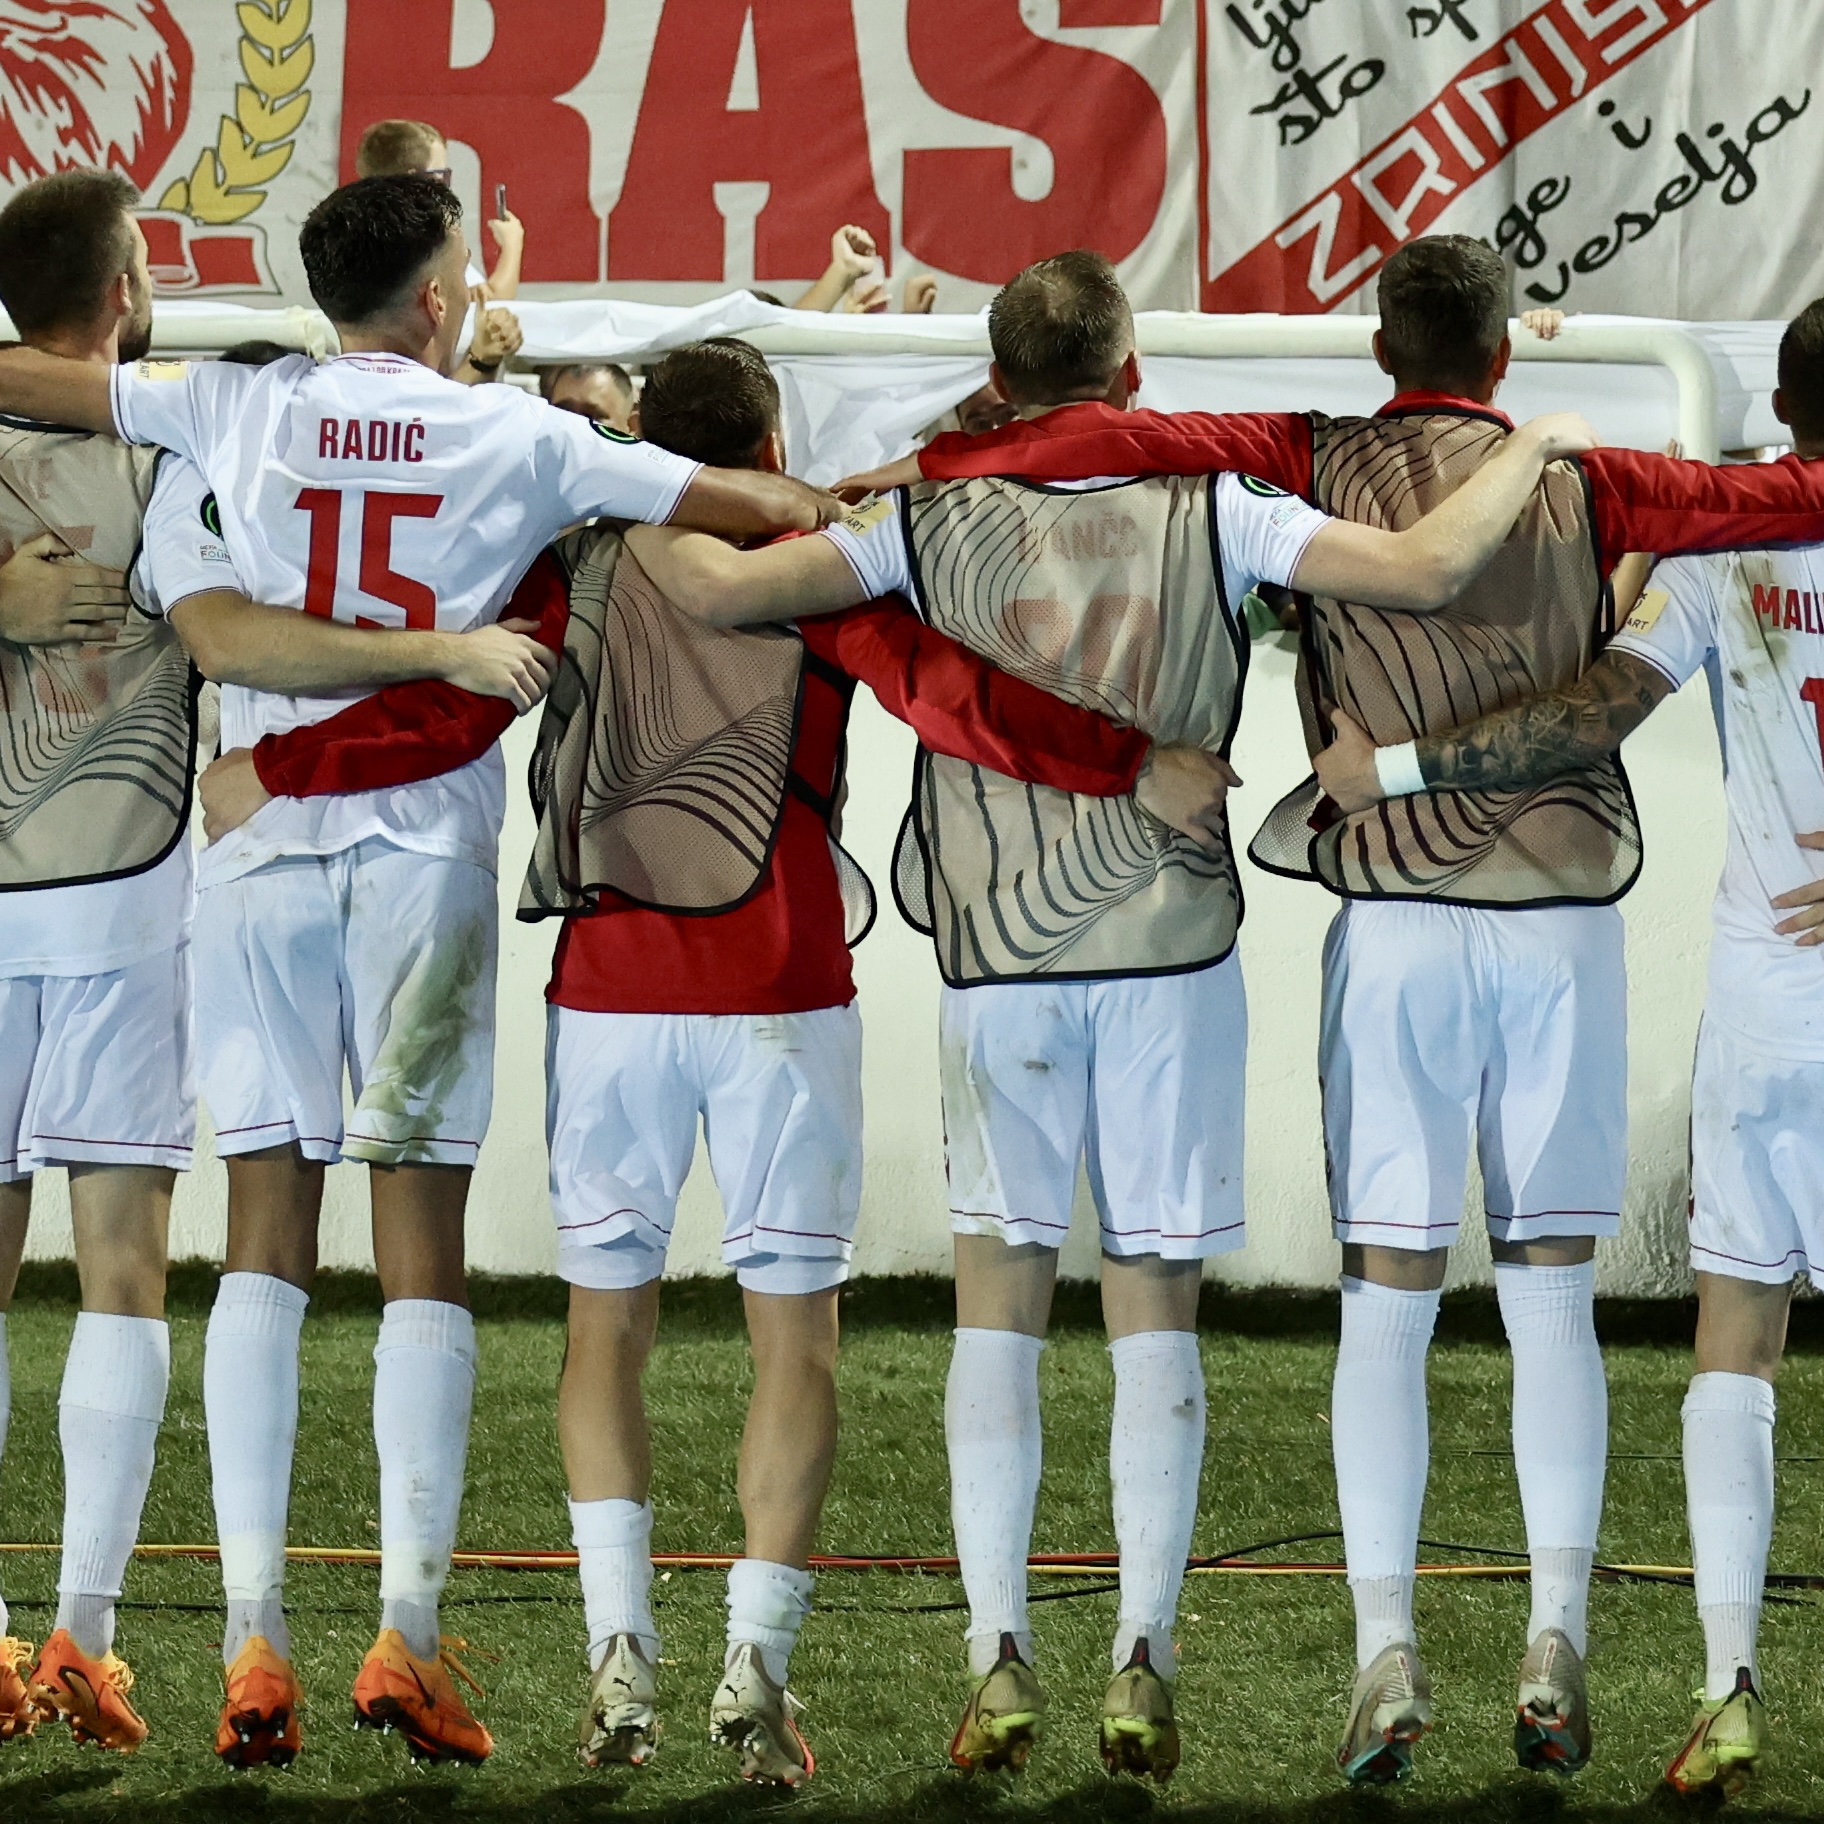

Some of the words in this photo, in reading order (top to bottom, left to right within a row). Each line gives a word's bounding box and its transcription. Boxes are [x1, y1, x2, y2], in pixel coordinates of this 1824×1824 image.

[1249, 54, 1386, 146] što
[1597, 99, 1652, 150] i
[1524, 88, 1811, 303] veselja
[318, 416, 426, 464] RADIĆ
[293, 487, 445, 632] 15
